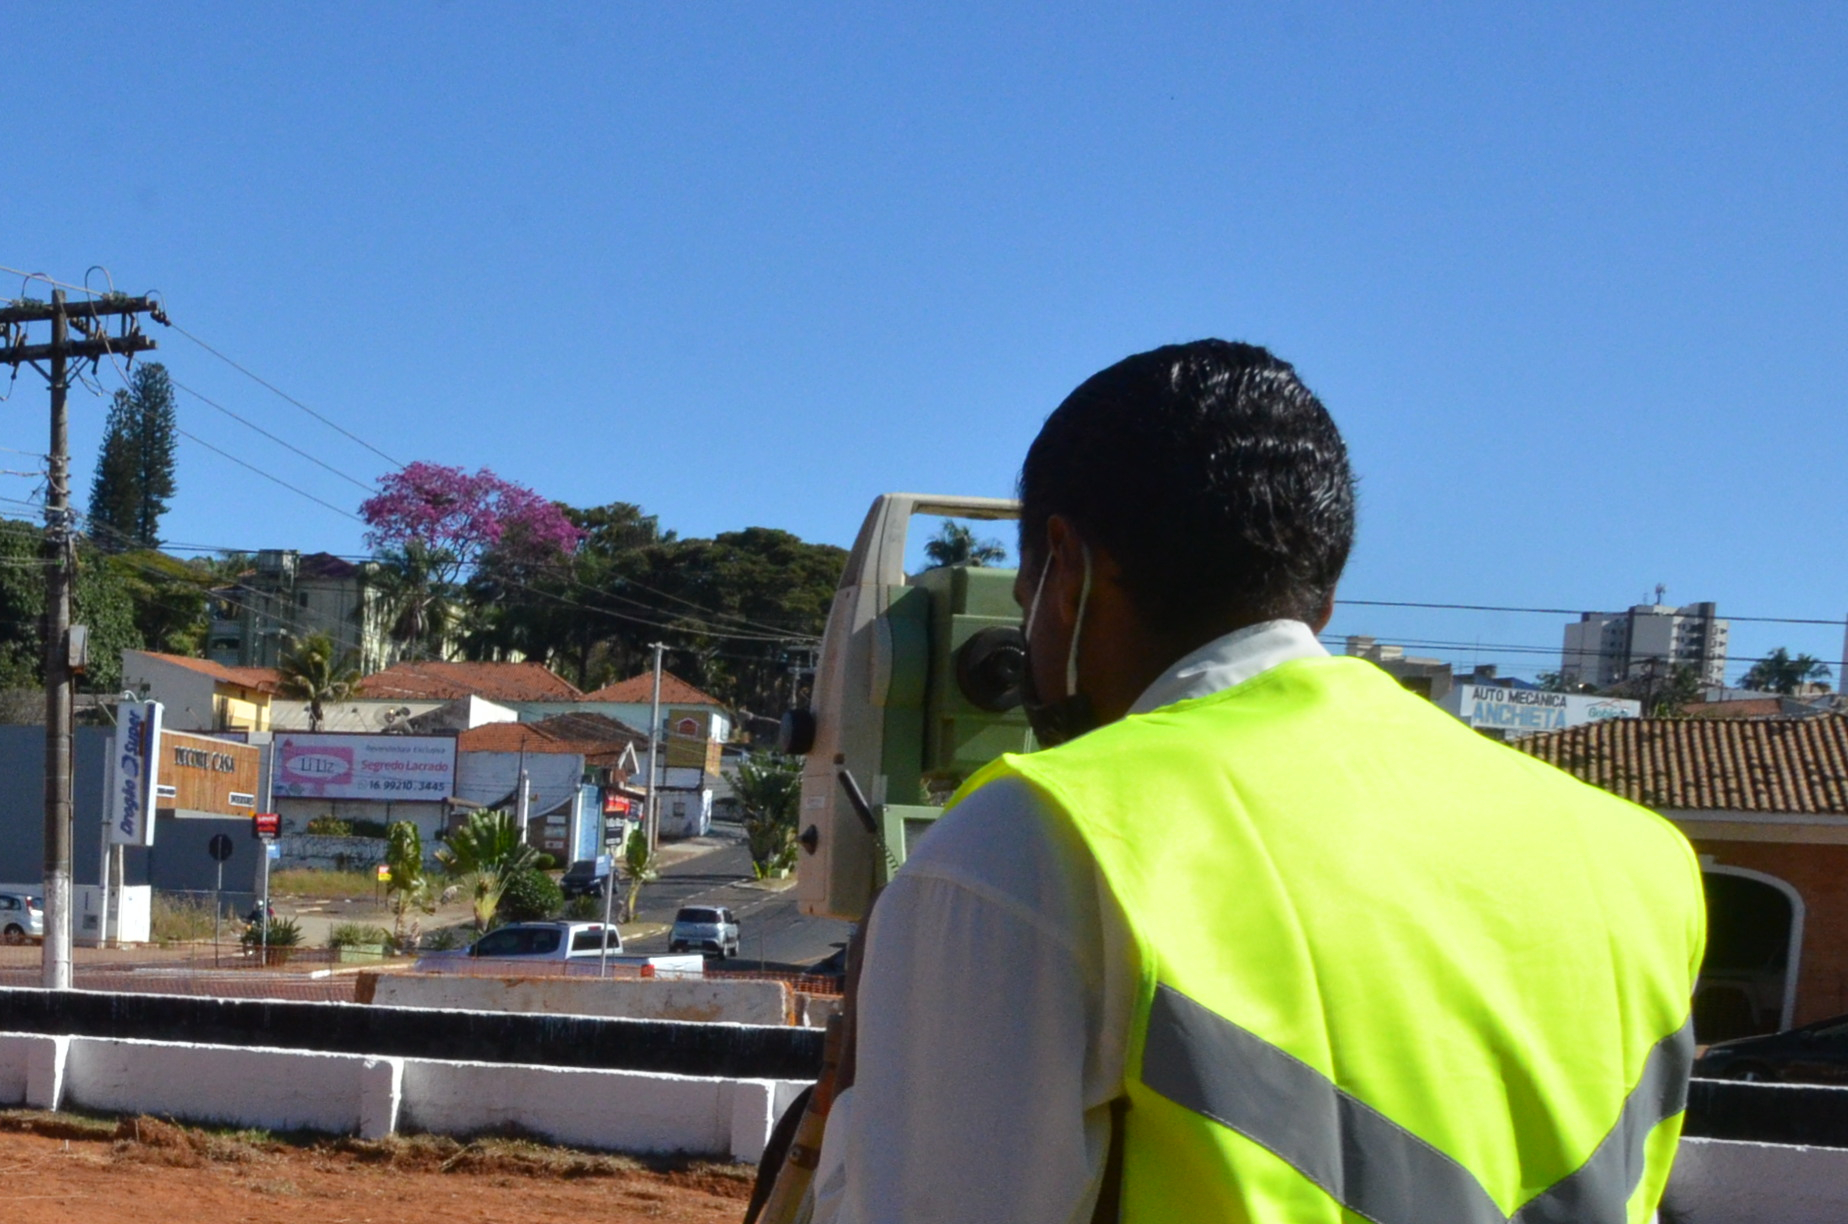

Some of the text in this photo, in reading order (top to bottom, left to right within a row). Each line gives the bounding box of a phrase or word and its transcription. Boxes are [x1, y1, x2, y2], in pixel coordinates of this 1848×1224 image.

[1472, 687, 1504, 701] AUTO
[1473, 702, 1567, 729] ANCHIETA
[212, 752, 235, 773] CASA
[361, 759, 449, 773] Segredo Lacrado
[120, 709, 140, 838] Drogão Super
